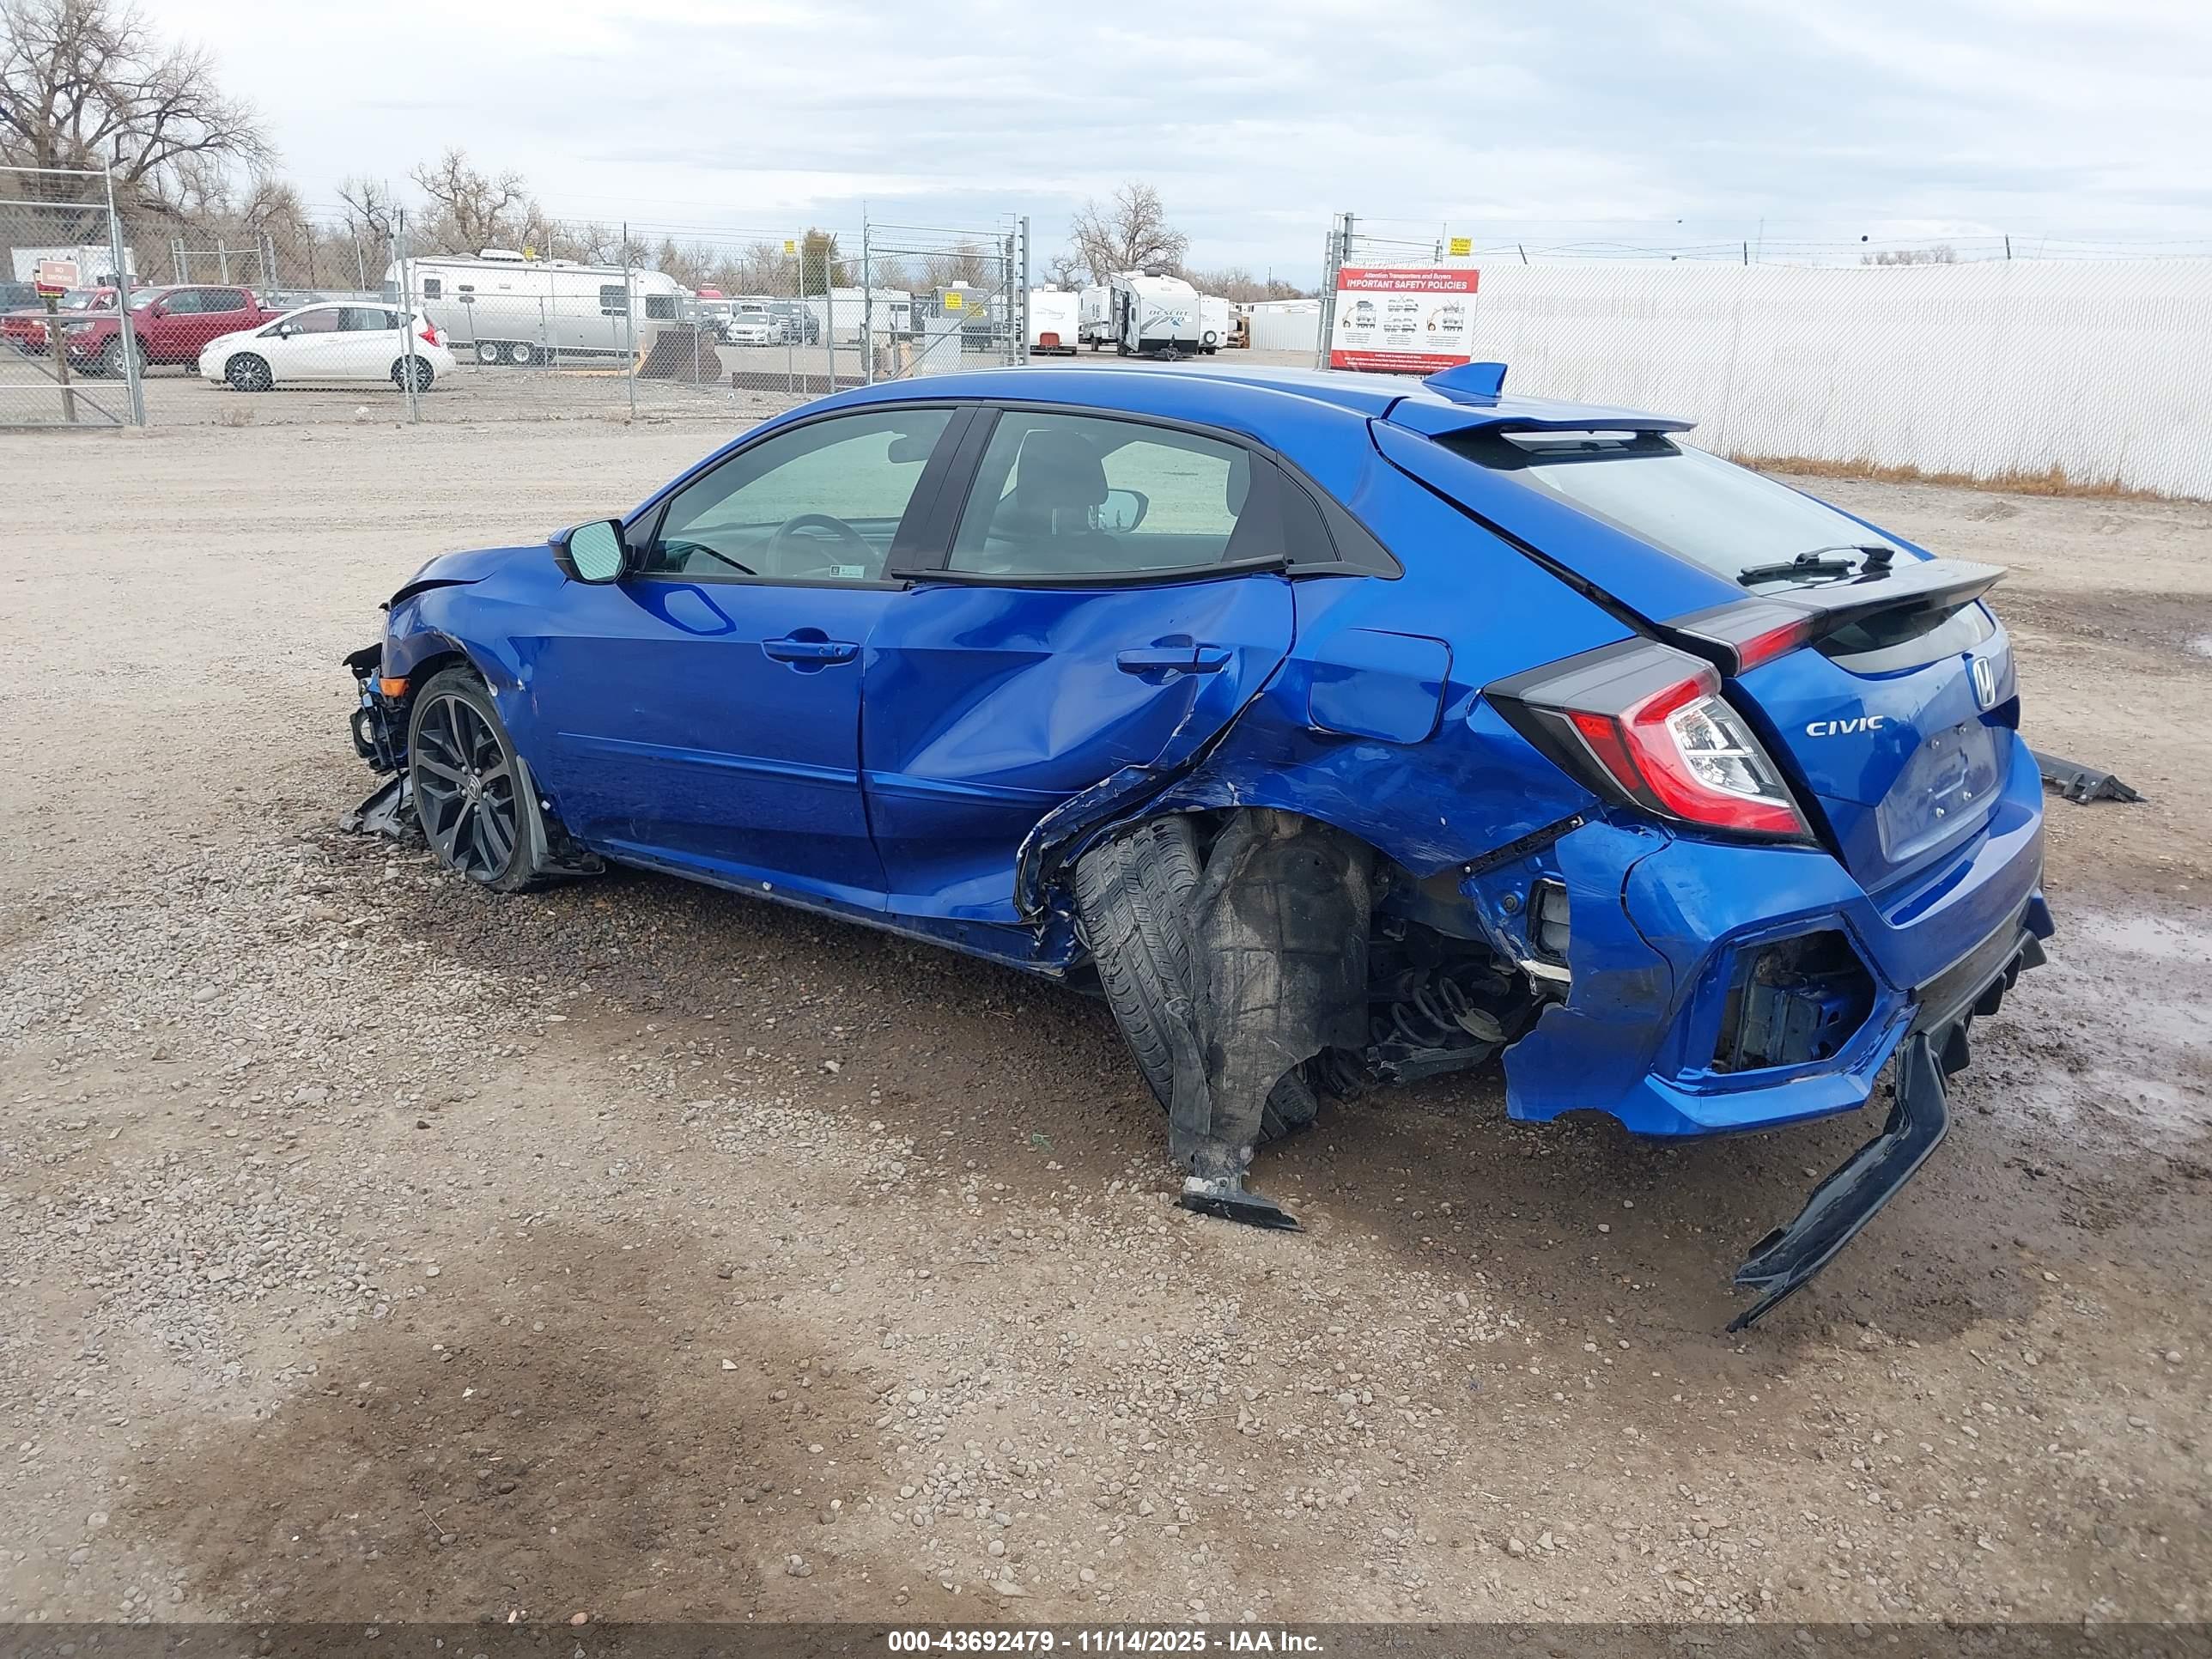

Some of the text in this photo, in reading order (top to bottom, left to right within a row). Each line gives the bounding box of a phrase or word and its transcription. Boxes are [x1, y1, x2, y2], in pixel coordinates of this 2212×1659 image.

[1346, 279, 1394, 288] IMPORTANT
[1395, 280, 1426, 289] SAFETY
[1806, 715, 1884, 737] CIVIC
